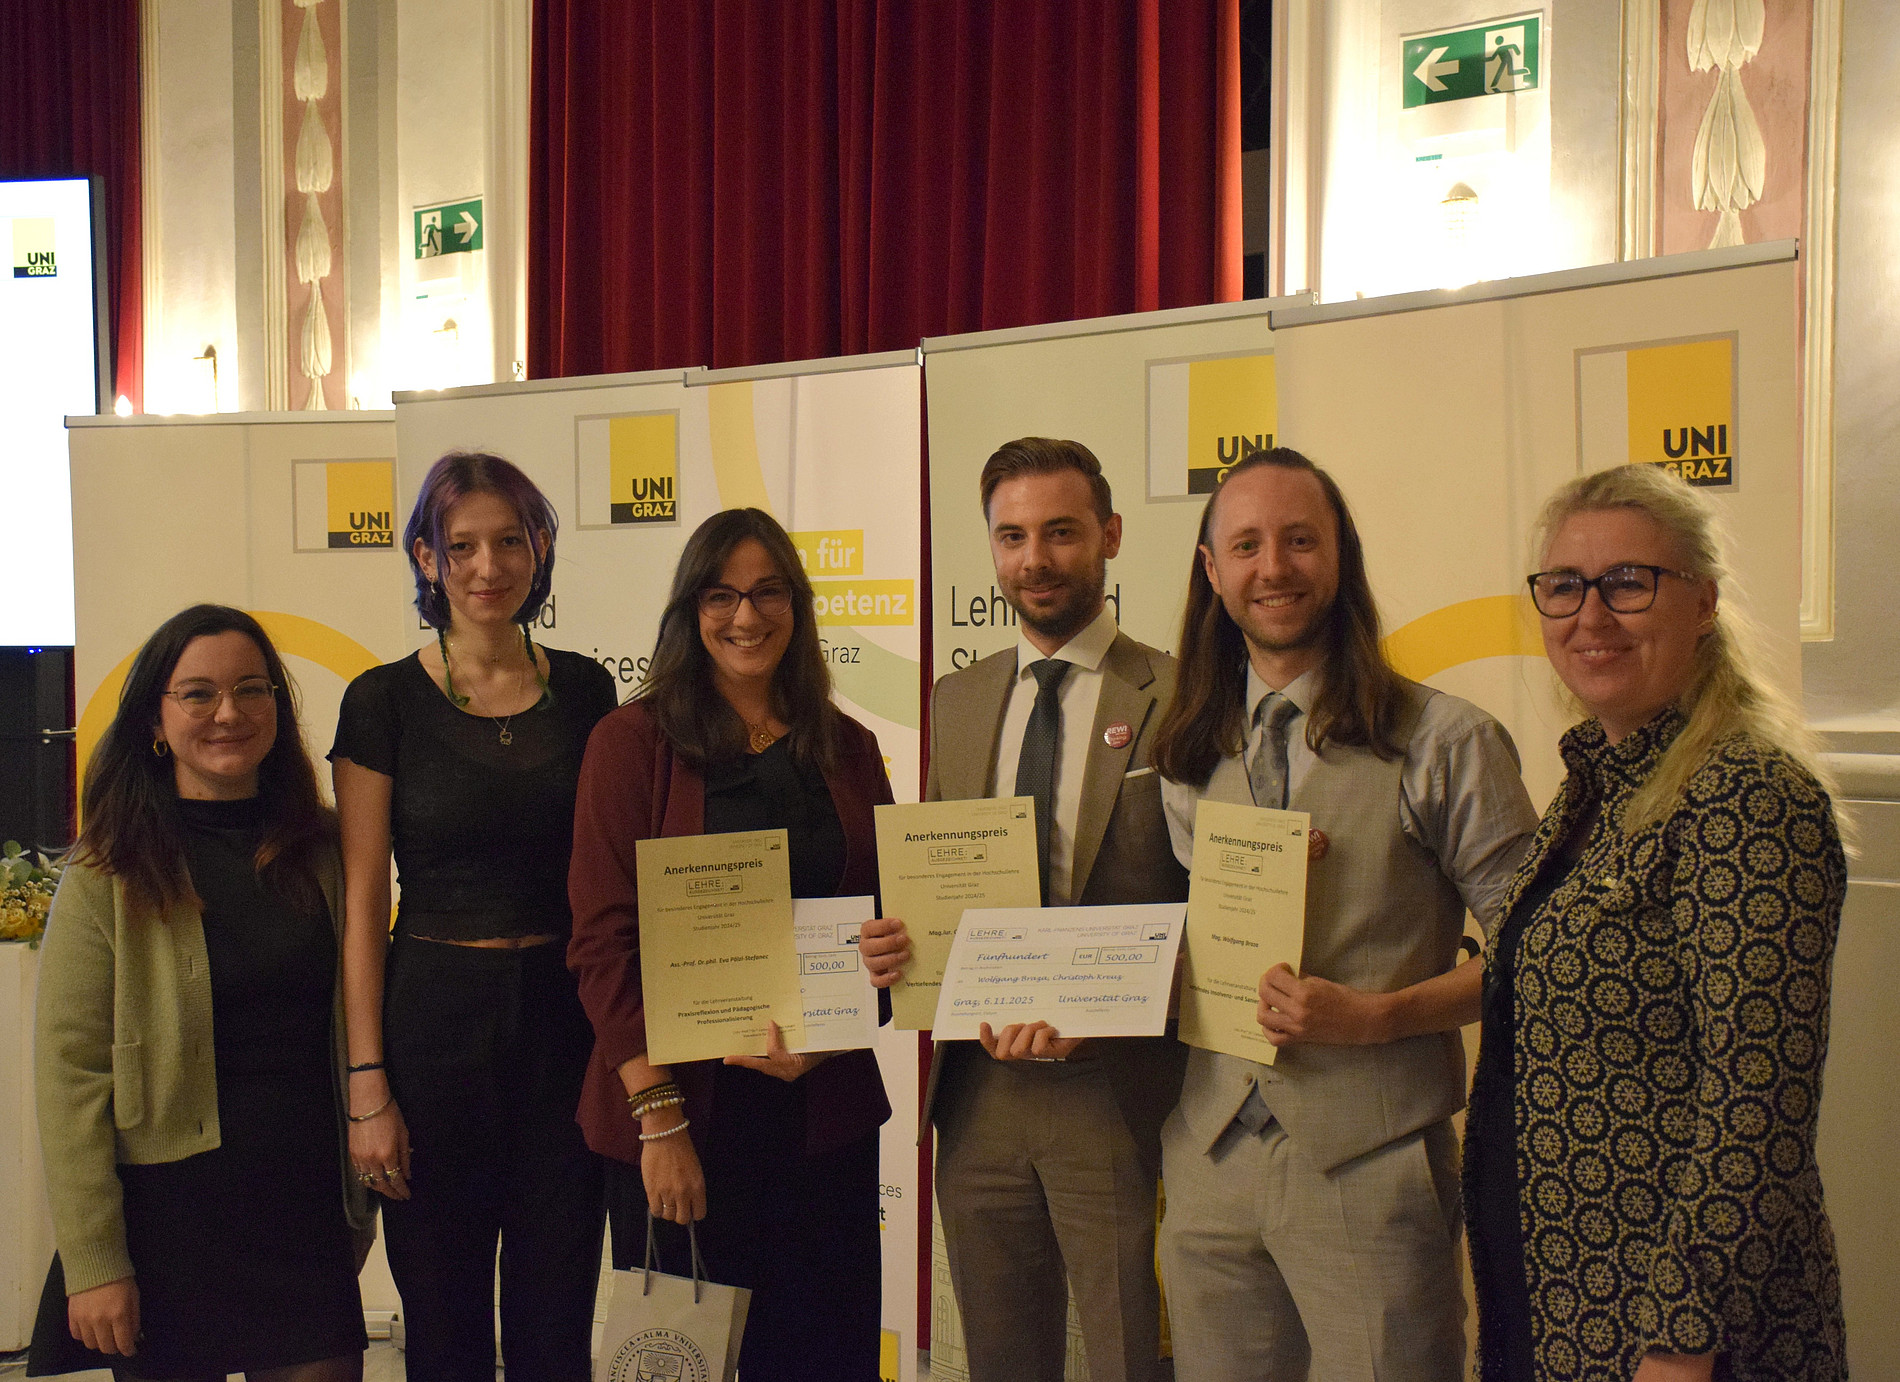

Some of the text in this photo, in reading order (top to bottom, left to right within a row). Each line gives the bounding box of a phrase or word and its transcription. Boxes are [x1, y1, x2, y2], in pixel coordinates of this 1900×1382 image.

[28, 252, 55, 265] UNI
[27, 266, 56, 275] GRAZ
[1663, 424, 1727, 458] UNI
[631, 477, 673, 500] UNI
[632, 501, 674, 518] GRAZ
[349, 511, 390, 530] UNI
[349, 531, 392, 544] GRAZ
[817, 537, 856, 568] für
[814, 589, 907, 617] petenz
[905, 827, 1008, 842] Anerkennungspreis
[1209, 833, 1283, 852] Anerkennungspreis
[930, 848, 968, 858] LEHRE:
[664, 859, 763, 876] Anerkennungspreis
[1106, 953, 1143, 961] 500,00
[809, 961, 845, 971] 500,00
[978, 976, 1020, 984] Wolfgang
[1053, 973, 1094, 982] Christoph
[984, 996, 1034, 1005] 6.11.2025
[1121, 994, 1149, 1004] Graz
[834, 1005, 860, 1016] Graz
[878, 1184, 902, 1199] ces
[643, 1331, 669, 1340] ALMA
[674, 1334, 708, 1382] VNIVERSITA
